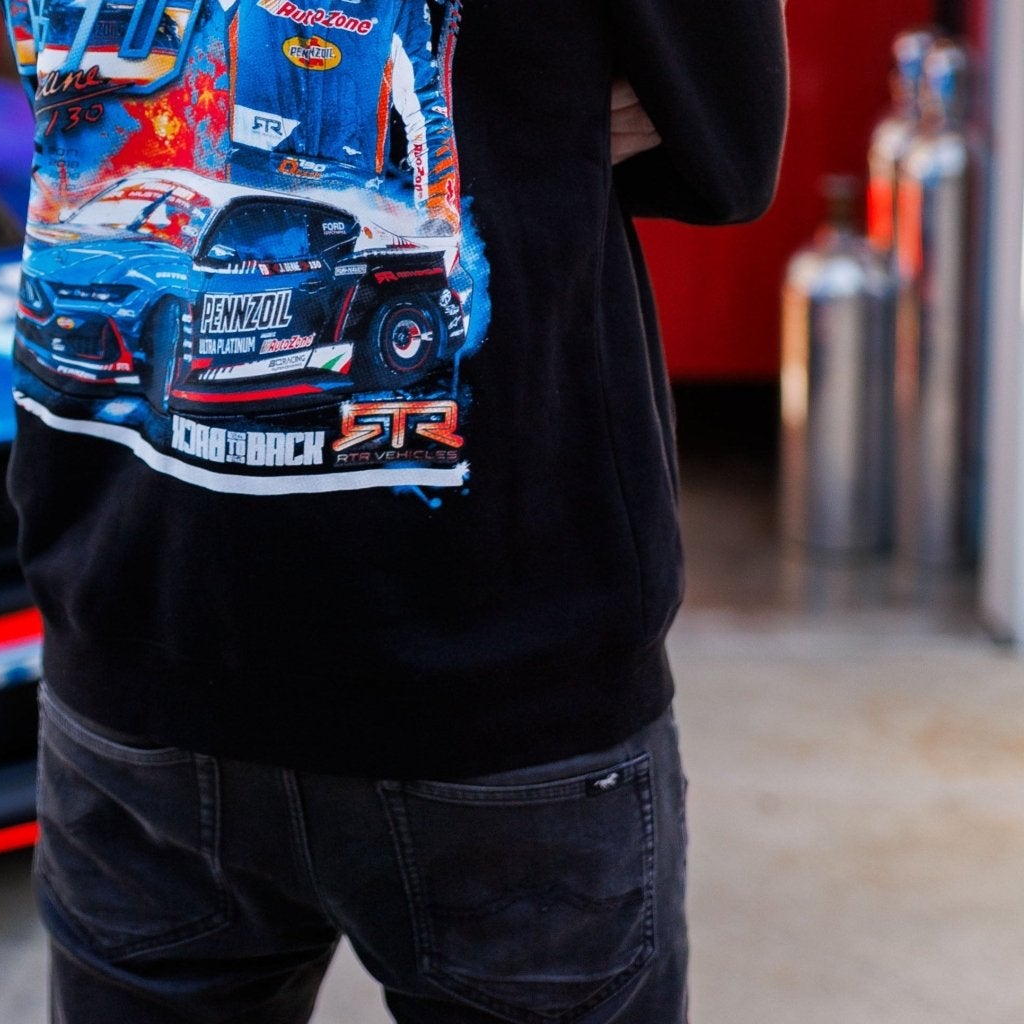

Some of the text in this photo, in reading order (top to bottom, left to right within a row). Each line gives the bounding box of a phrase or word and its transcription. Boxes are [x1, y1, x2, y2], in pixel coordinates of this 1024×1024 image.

[275, 0, 373, 36] AutoZone
[289, 45, 335, 59] PENNZOIL
[45, 103, 104, 136] 130
[322, 222, 345, 231] FORD
[200, 290, 292, 333] PENNZOIL
[216, 337, 256, 355] PLATINUM
[269, 335, 314, 352] AutoZone
[228, 439, 246, 456] TO
[246, 431, 325, 466] BACK
[337, 450, 458, 463] RTR VEHICLES
